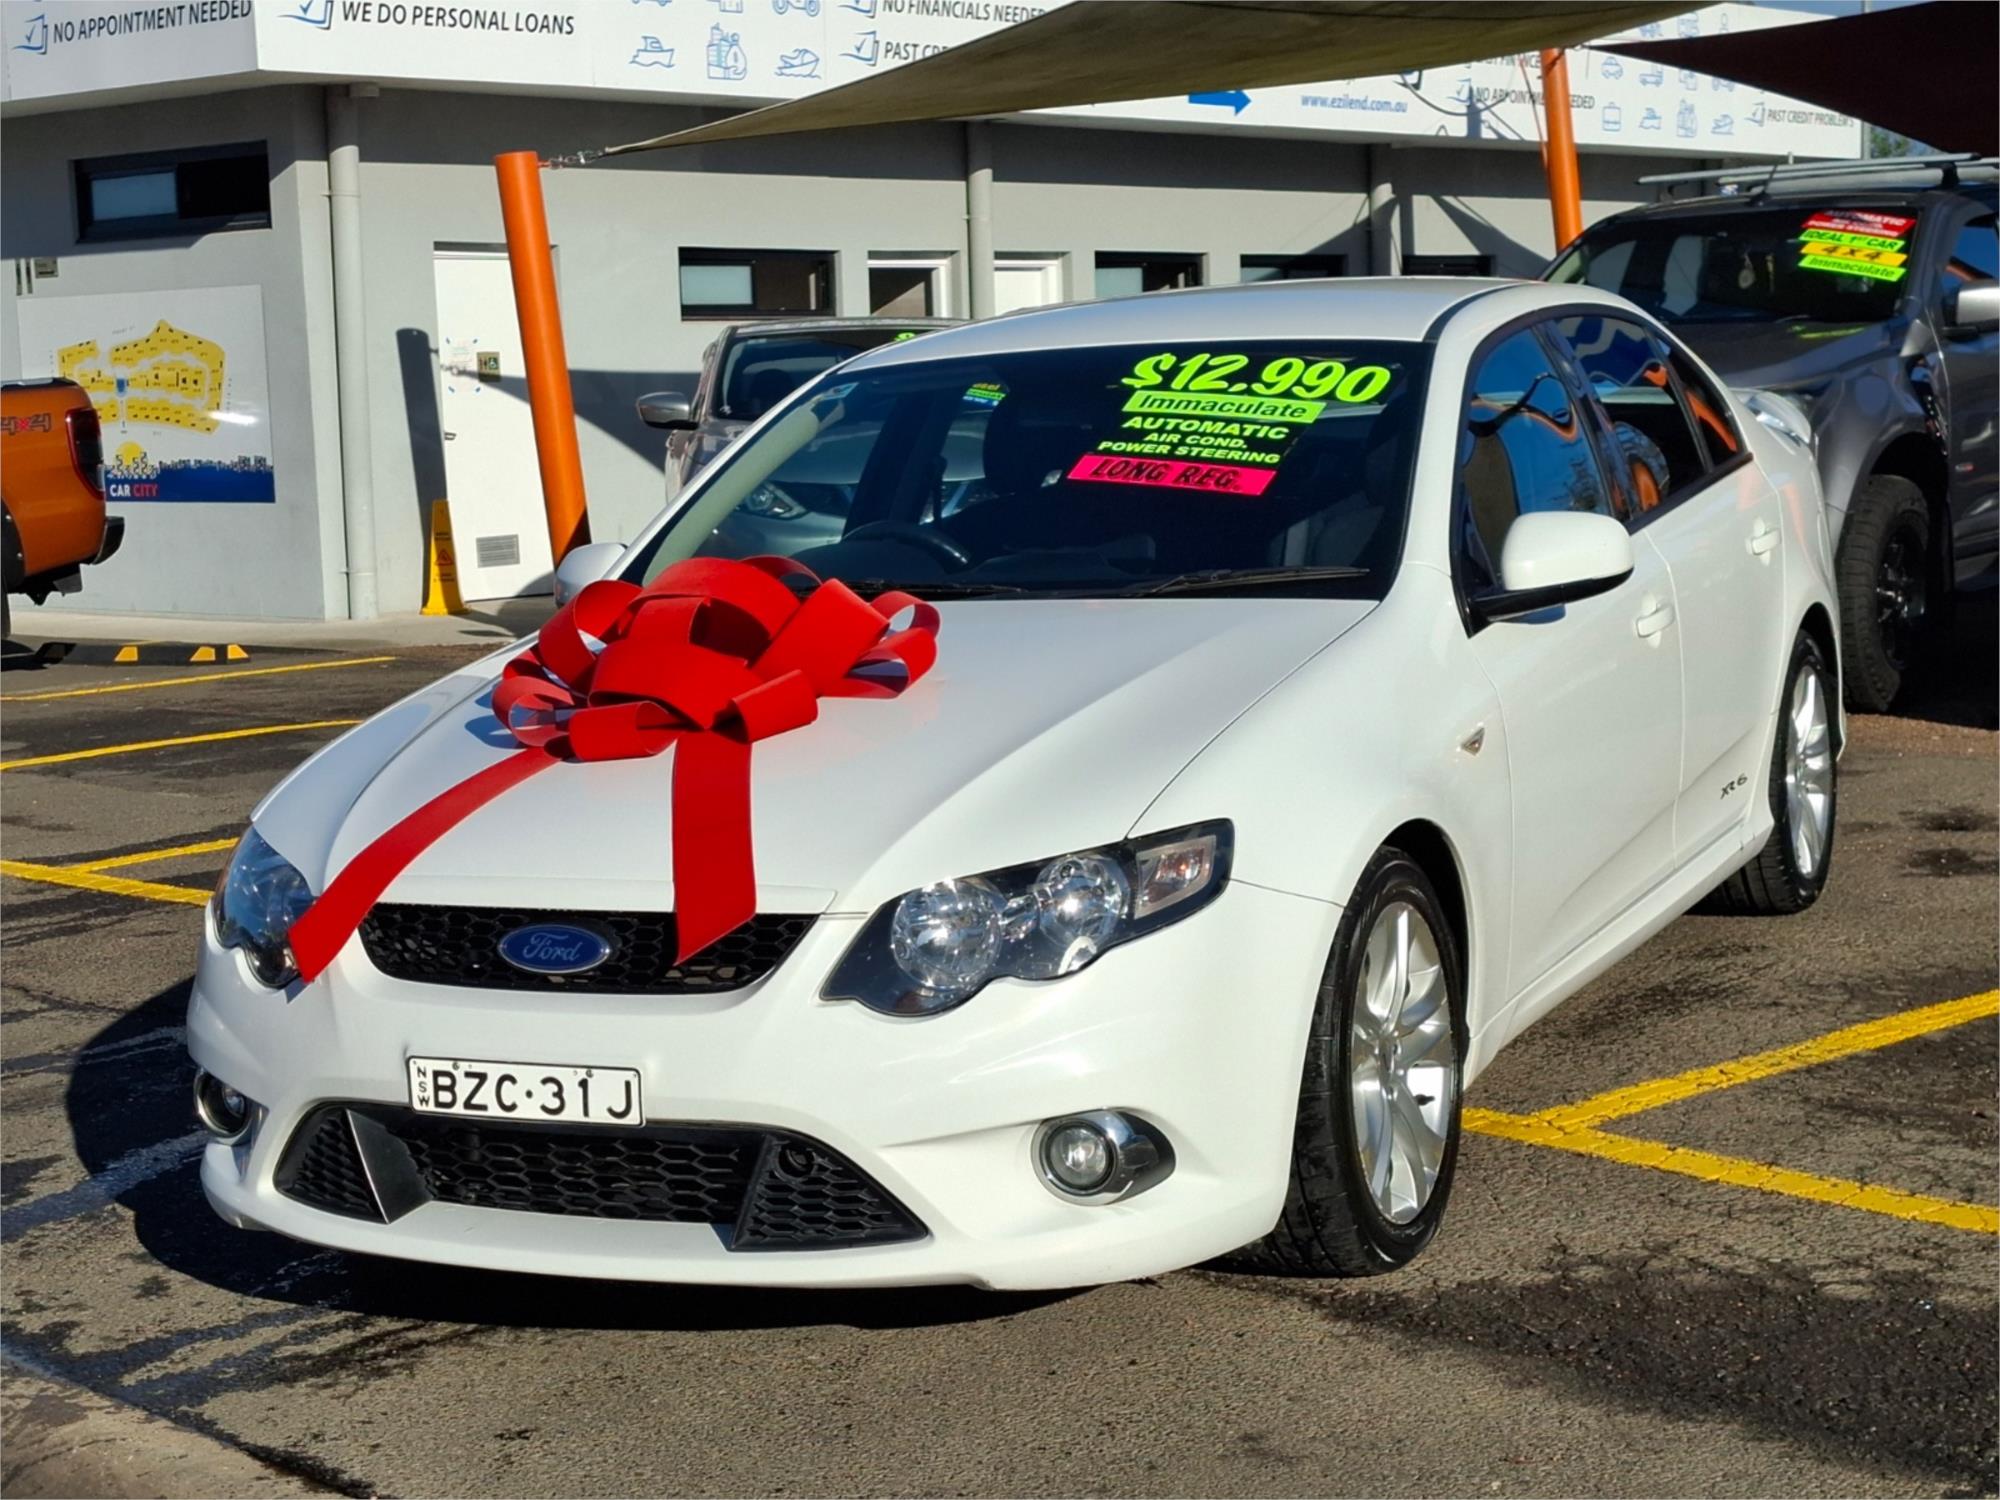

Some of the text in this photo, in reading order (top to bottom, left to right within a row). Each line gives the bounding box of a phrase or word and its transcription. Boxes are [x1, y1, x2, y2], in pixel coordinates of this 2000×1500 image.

[53, 0, 252, 43] NO APPOINTMENT NEEDED
[342, 1, 575, 35] WE DO PERSONAL LOANS
[908, 0, 990, 21] FINANCIALS
[884, 41, 919, 62] PAST
[1301, 94, 1408, 113] www.ezilend.com.au
[1866, 239, 1898, 250] CAR
[1809, 257, 1896, 278] Immaculate
[1139, 394, 1306, 418] Immaculate
[1122, 416, 1290, 440] AUTOMATIC
[1143, 432, 1249, 450] AIR COND.
[1097, 441, 1281, 464] POWER STEERING
[1090, 458, 1244, 492] LONG REG.
[110, 483, 158, 497] CAR CITY
[523, 932, 583, 960] Ford
